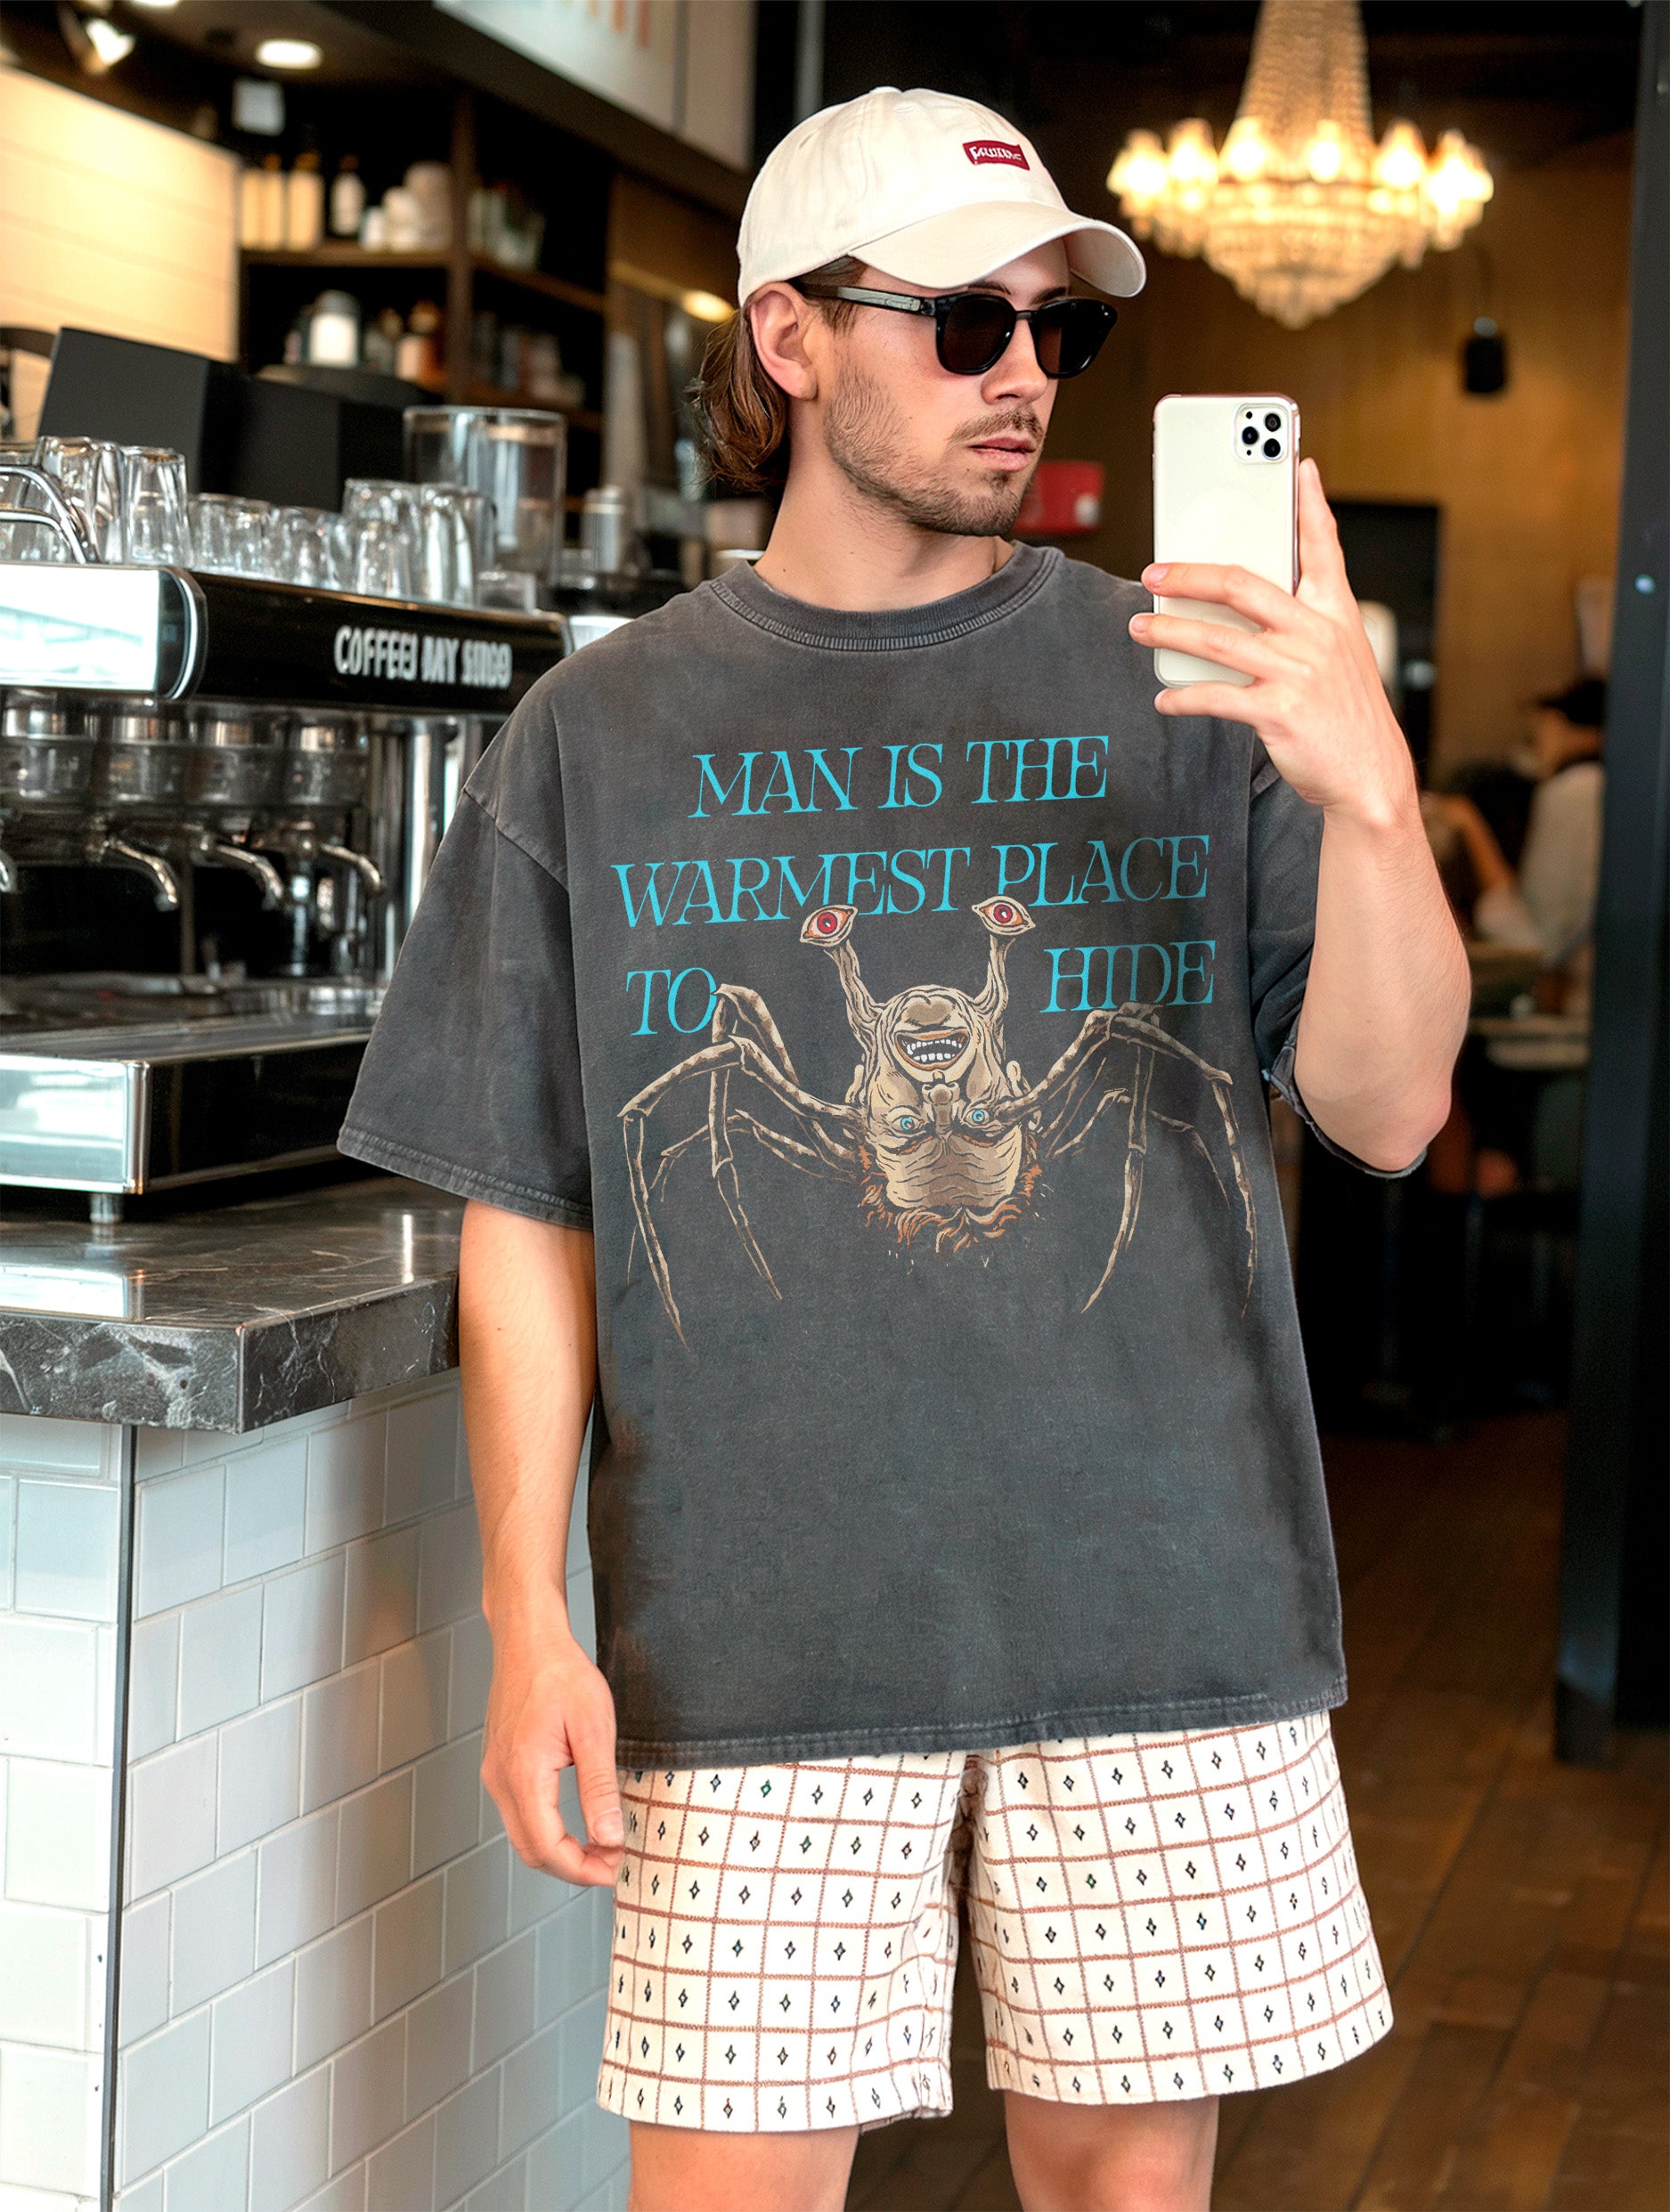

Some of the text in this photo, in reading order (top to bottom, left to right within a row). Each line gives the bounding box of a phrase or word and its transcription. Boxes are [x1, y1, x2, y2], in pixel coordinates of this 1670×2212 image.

[688, 736, 1109, 817] MAN IS THE
[610, 835, 1209, 928] WARMEST PLACE
[626, 940, 1216, 1036] TO HIDE
